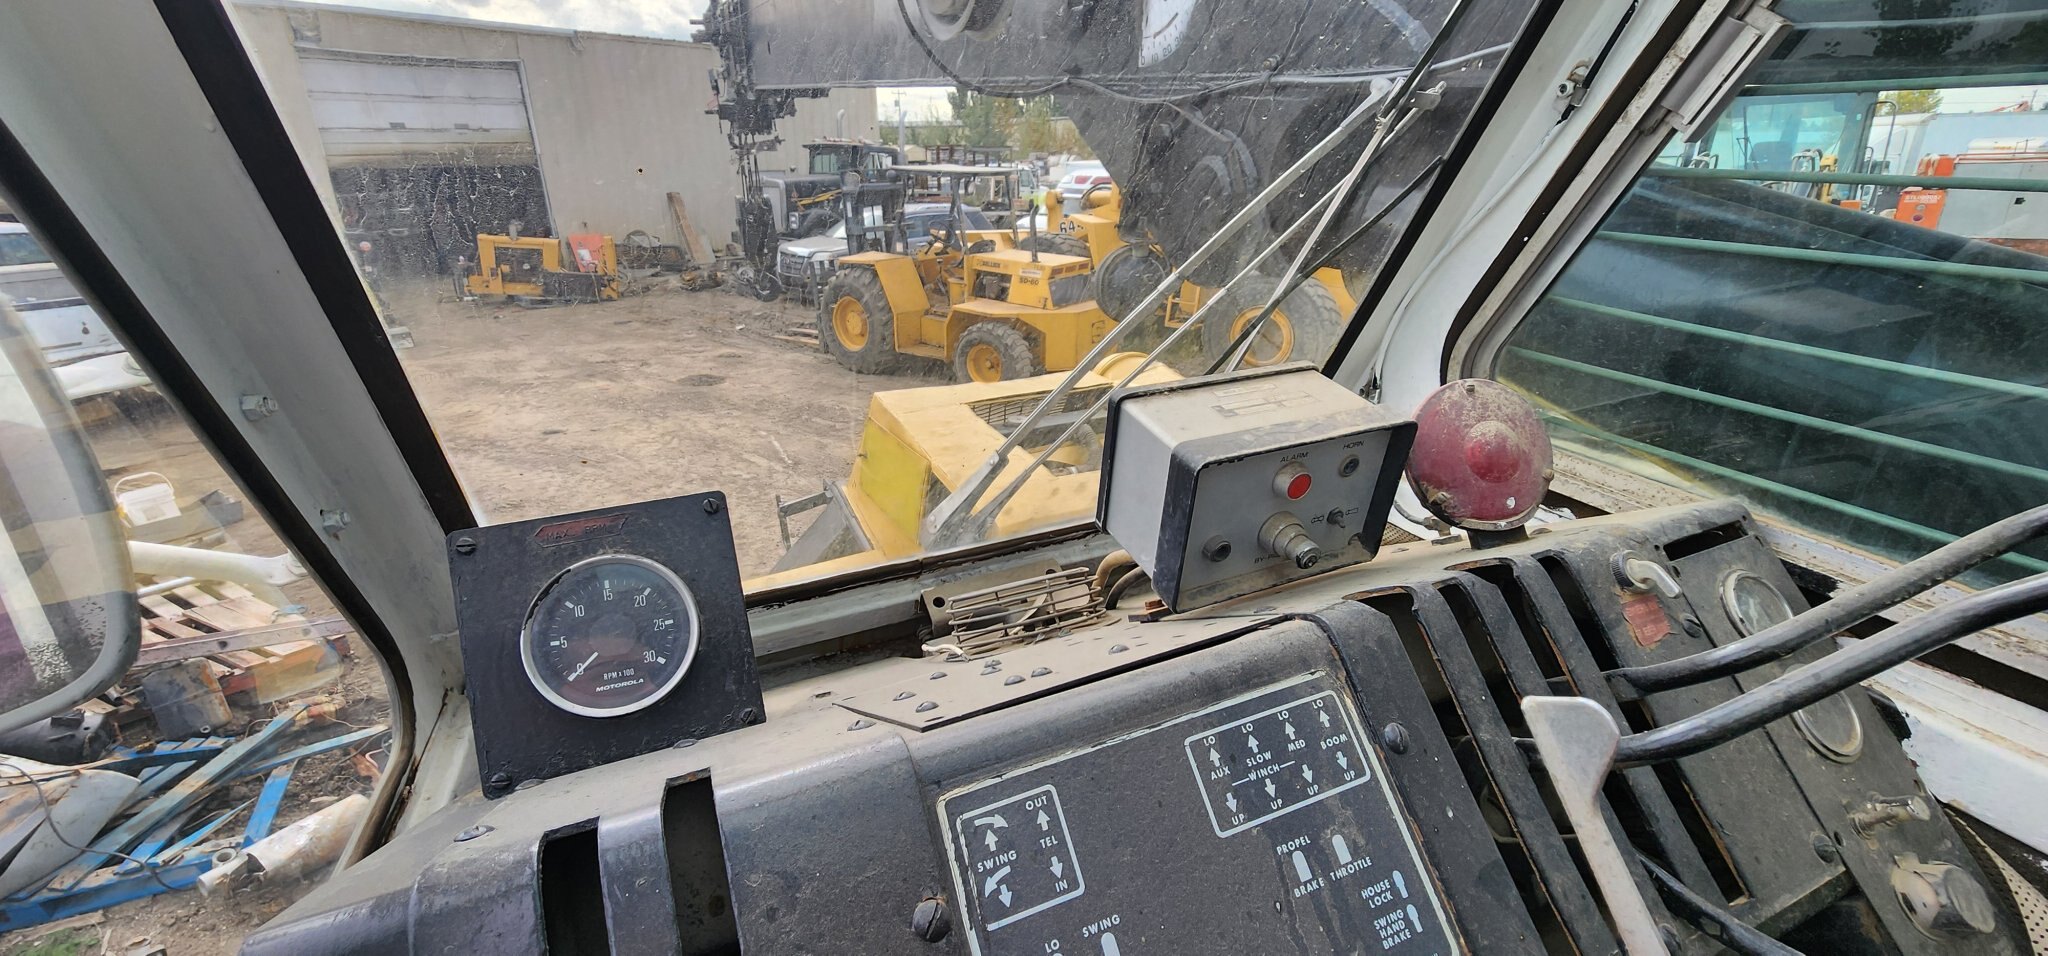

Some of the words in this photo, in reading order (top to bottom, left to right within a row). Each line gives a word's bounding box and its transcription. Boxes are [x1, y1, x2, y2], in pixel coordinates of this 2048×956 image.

[1152, 53, 1158, 64] 10
[1343, 440, 1365, 450] HORN
[1280, 452, 1309, 463] ALARM
[603, 588, 613, 601] 15
[633, 594, 646, 607] 20
[574, 604, 585, 617] 10
[653, 618, 665, 631] 25
[560, 635, 568, 649] 5
[643, 649, 656, 663] 30
[576, 662, 584, 675] 0
[603, 671, 618, 681] RPM
[623, 668, 635, 676] 100
[595, 678, 644, 692] MOTOROLA
[1312, 699, 1324, 709] LO
[1277, 710, 1289, 721] LO
[1241, 722, 1254, 734] LO
[1203, 735, 1216, 747] LO
[1287, 739, 1306, 752] MED
[1320, 733, 1348, 750] BOOM
[1246, 750, 1272, 767] SLOW
[1210, 766, 1231, 780] AUX
[1248, 763, 1280, 782] WINCH
[1343, 770, 1356, 781] UP
[1307, 784, 1319, 796] UP
[1025, 796, 1048, 811] OUT
[1270, 798, 1283, 810] UP
[1231, 813, 1245, 825] UP
[1039, 835, 1058, 849] TEL
[1276, 835, 1311, 856] PROPEL
[977, 850, 1017, 873] SWING
[1330, 856, 1373, 881] THROTTLE
[1055, 880, 1068, 893] IN
[1293, 877, 1325, 898] BRAKE
[1361, 879, 1391, 900] HOUSE
[1368, 890, 1394, 909] LOCK
[1082, 914, 1121, 938] SWING
[1373, 909, 1404, 930] SWING
[1379, 919, 1406, 939] HAND
[1045, 939, 1060, 953] LO
[1382, 929, 1412, 950] BRAKE
